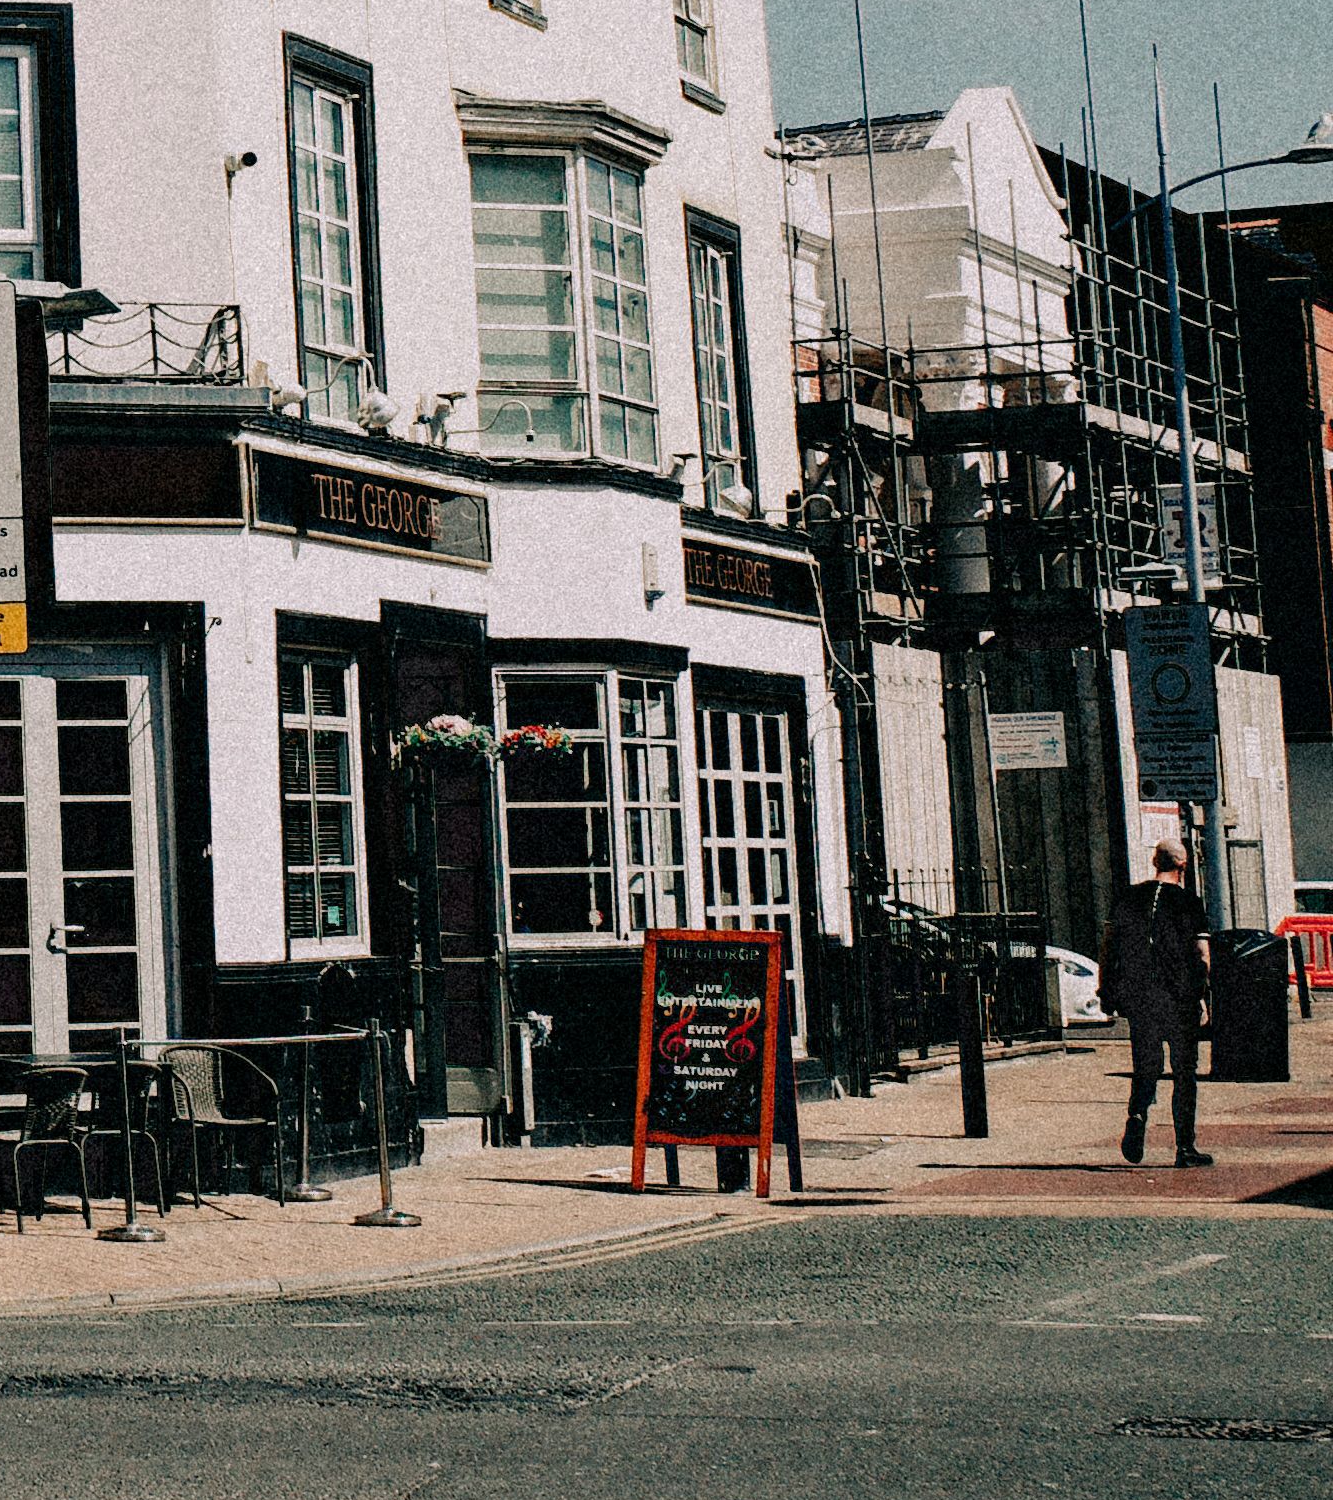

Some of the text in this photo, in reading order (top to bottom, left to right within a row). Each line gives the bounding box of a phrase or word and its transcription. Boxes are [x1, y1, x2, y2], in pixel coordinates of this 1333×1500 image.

[311, 473, 442, 541] THE GEORGE
[683, 547, 773, 598] THE GEORGE
[695, 983, 724, 994] LIVE
[687, 1024, 728, 1036] EVERY
[685, 1038, 729, 1050] FRIDAY
[673, 1065, 739, 1077] SATURDAY
[685, 1079, 726, 1091] NIGHT
